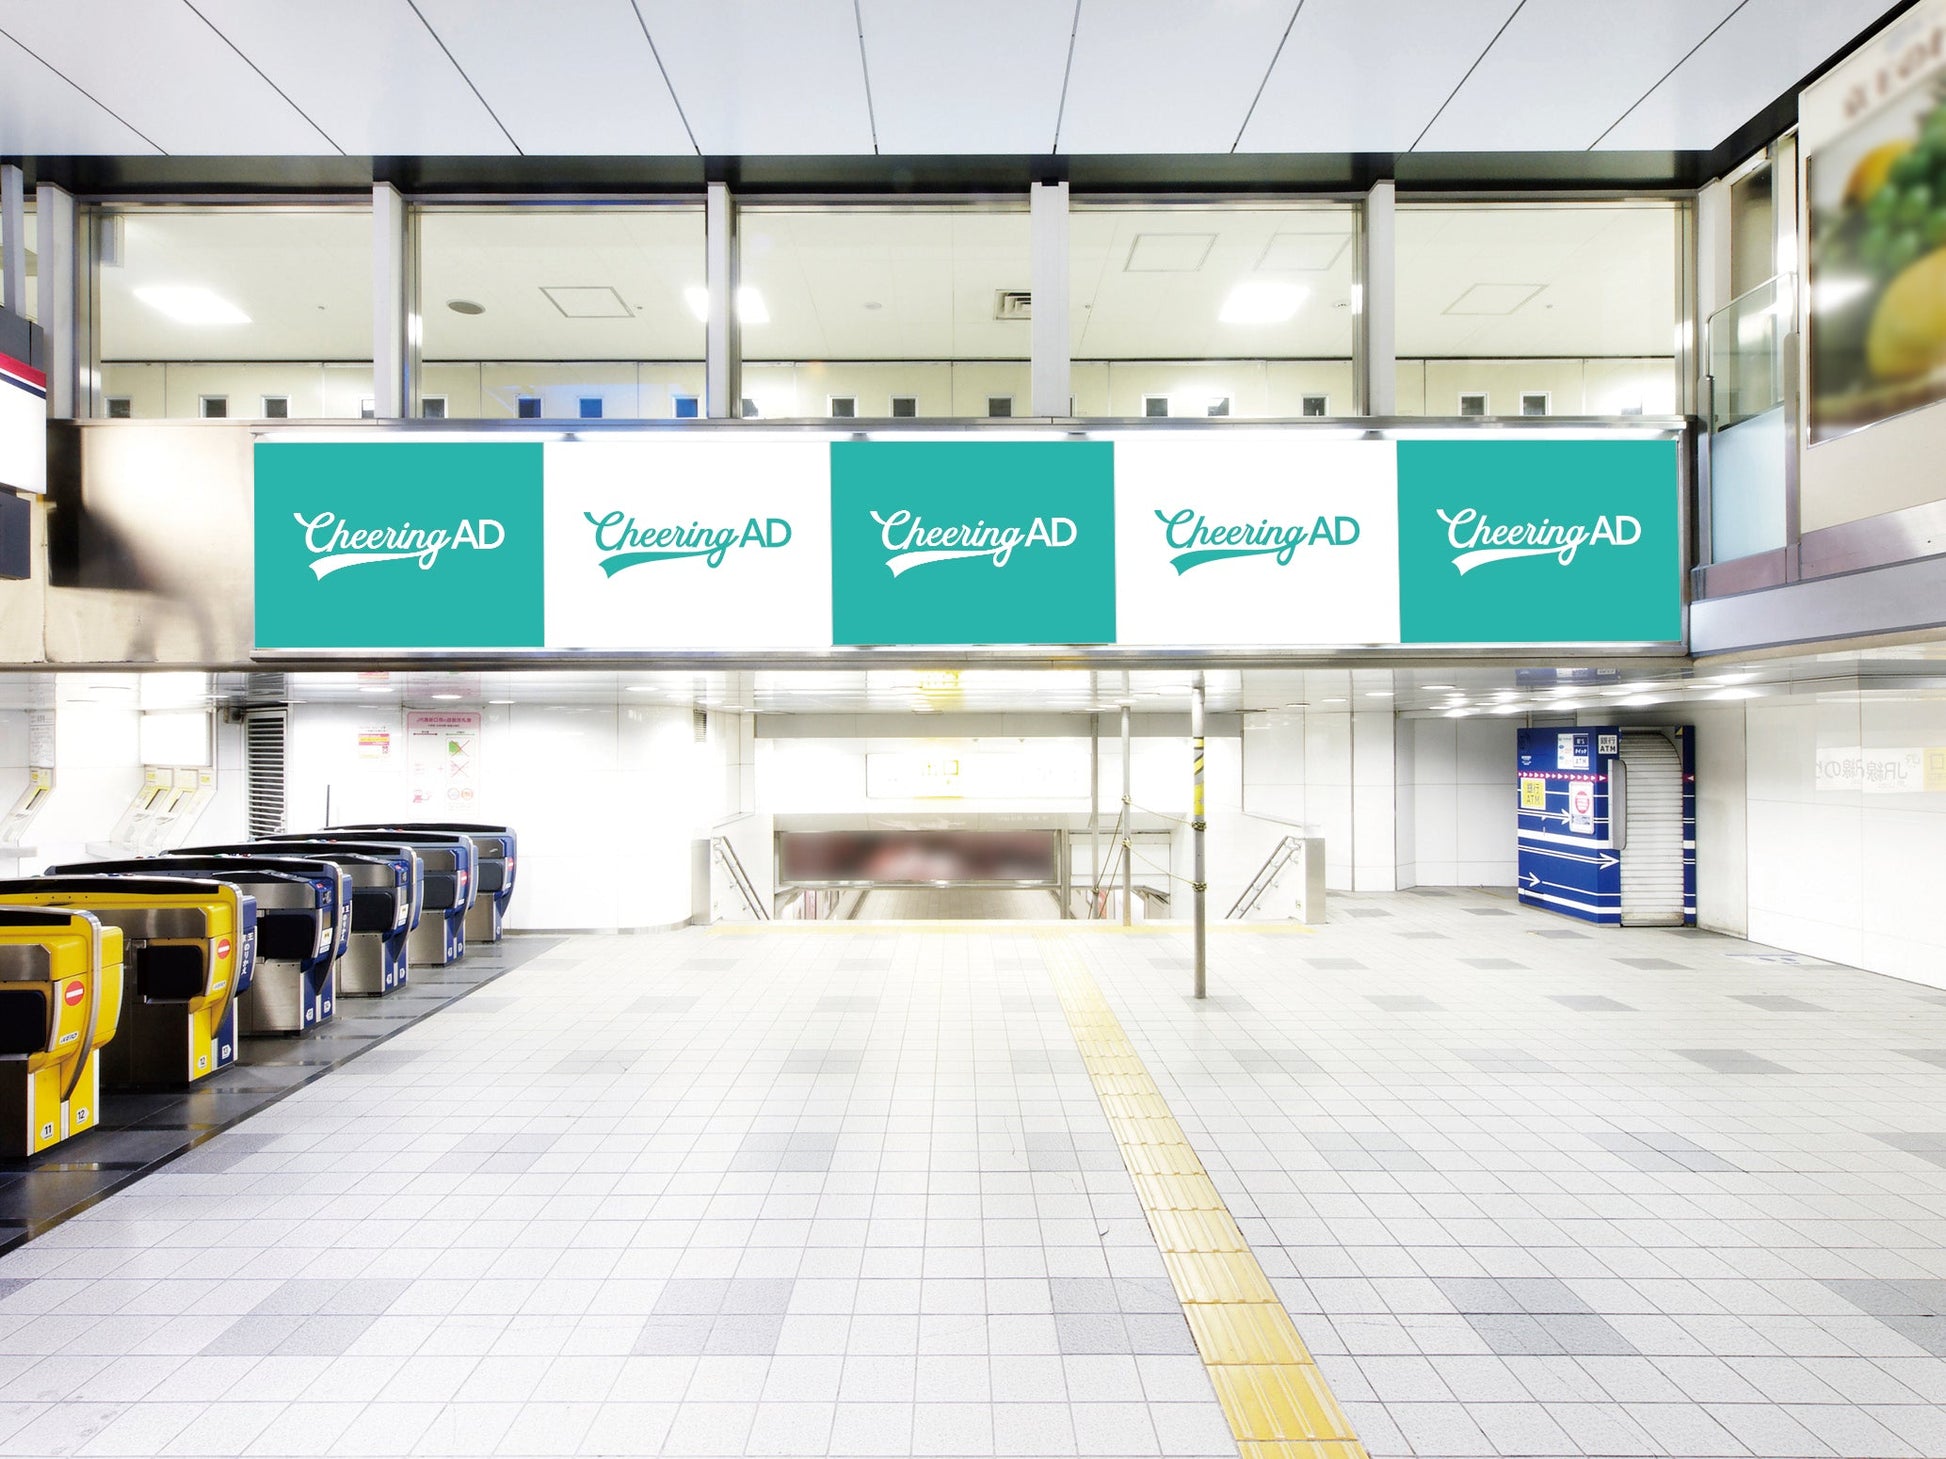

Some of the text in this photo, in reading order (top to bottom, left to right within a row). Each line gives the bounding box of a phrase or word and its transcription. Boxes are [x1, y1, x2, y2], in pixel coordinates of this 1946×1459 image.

[294, 512, 506, 573] Cheering AD
[584, 511, 792, 572] Cheering AD
[870, 510, 1078, 571] Cheering AD
[1155, 509, 1361, 570] Cheering AD
[1437, 508, 1642, 570] Cheering AD
[1600, 745, 1616, 753] ATM
[45, 1124, 52, 1135] 11
[78, 1109, 85, 1120] 12
